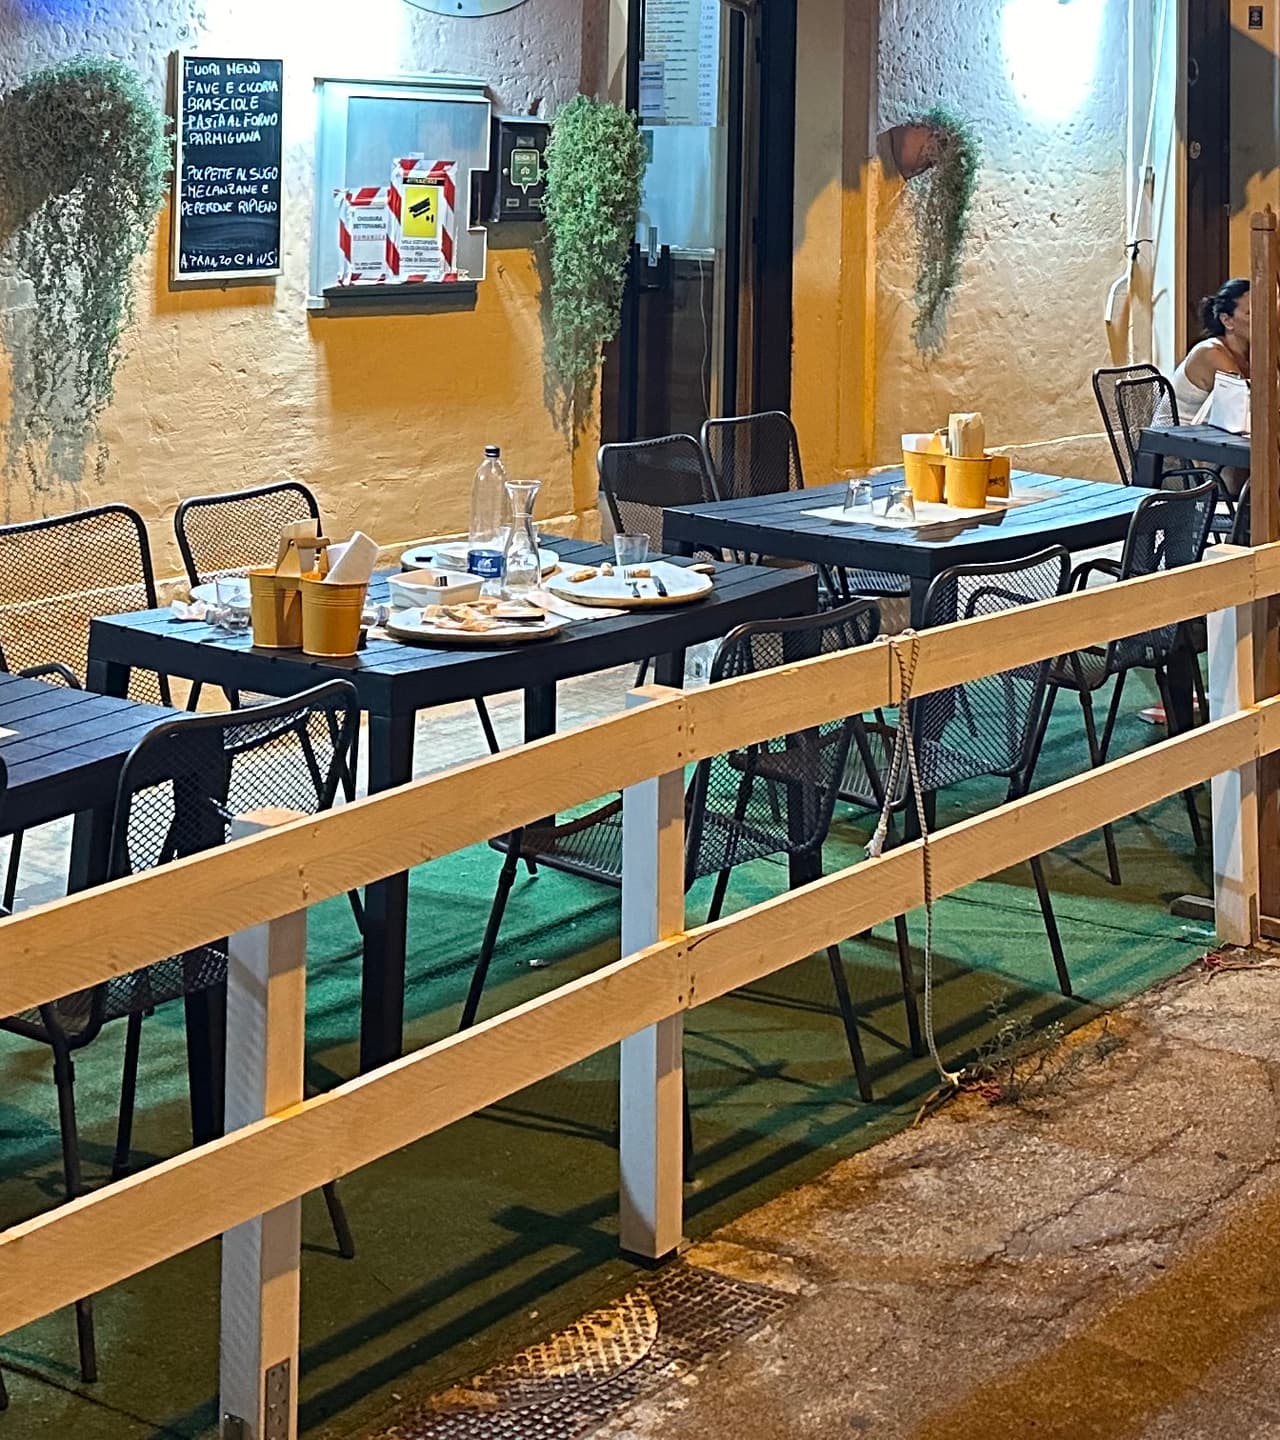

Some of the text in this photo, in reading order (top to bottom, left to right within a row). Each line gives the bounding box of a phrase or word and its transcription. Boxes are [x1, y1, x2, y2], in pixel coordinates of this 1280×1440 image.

[185, 60, 221, 77] FUORI
[187, 80, 220, 95] FAVE
[225, 81, 234, 94] E
[186, 95, 260, 112] BRASCIOLE
[227, 114, 242, 128] AL
[243, 112, 278, 128] FORNO
[186, 165, 279, 181] POLPETTE AL SUGO
[187, 182, 258, 199] MELANZANE
